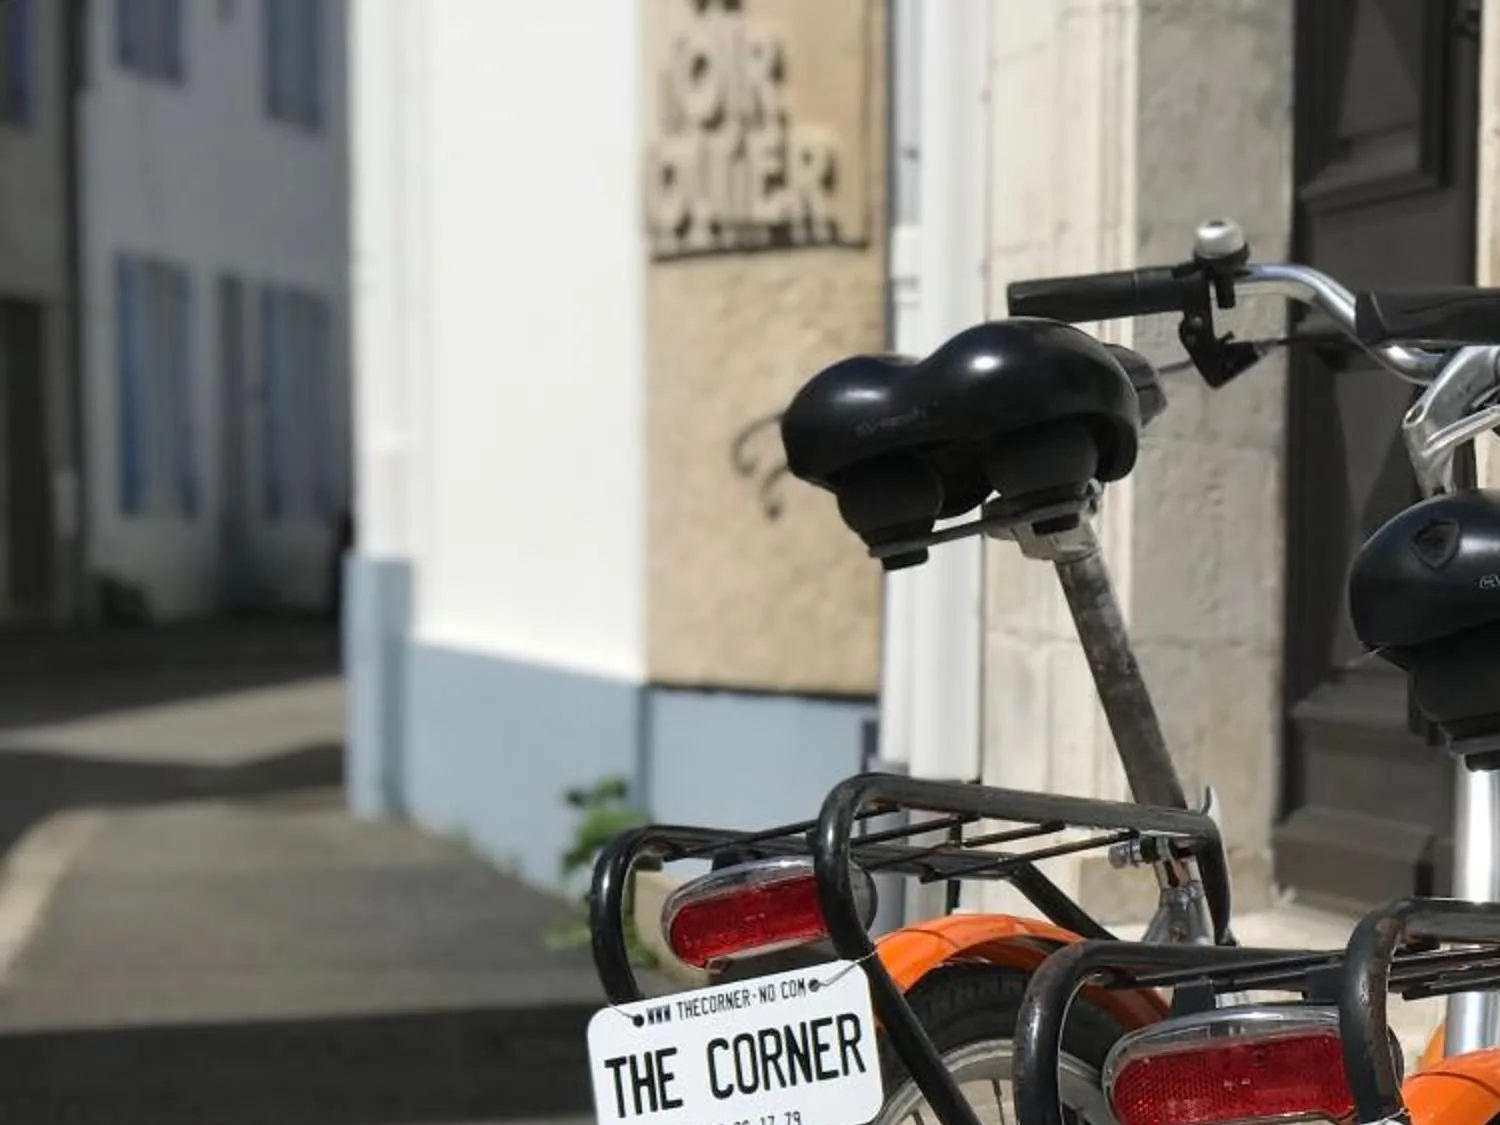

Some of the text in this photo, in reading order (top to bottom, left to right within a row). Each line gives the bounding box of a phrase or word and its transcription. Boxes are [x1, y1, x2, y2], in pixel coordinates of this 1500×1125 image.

[645, 1004, 672, 1026] WWW
[780, 976, 808, 1000] COM
[604, 1013, 867, 1119] THE CORNER
